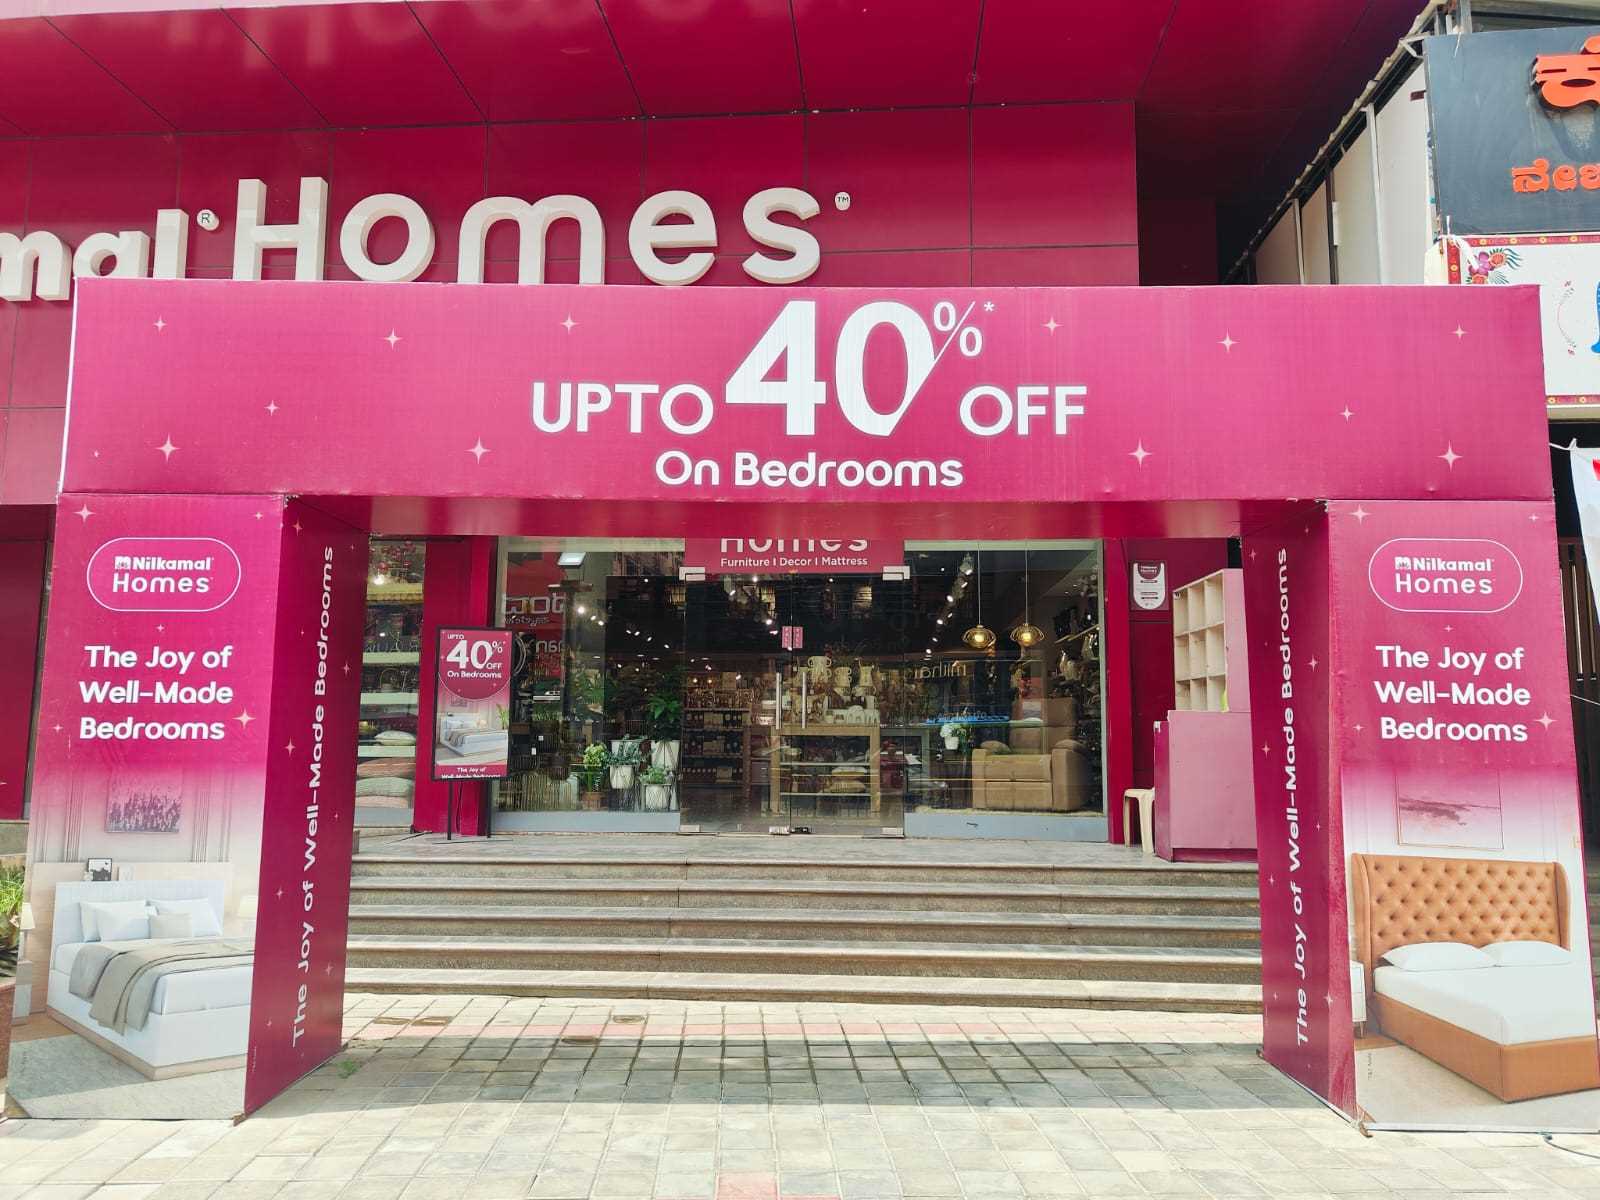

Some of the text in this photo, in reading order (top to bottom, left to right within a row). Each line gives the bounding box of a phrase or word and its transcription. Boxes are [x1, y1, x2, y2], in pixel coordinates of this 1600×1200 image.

[532, 381, 714, 435] UPTO
[959, 385, 1088, 436] OFF
[655, 450, 964, 489] On Bedrooms
[132, 556, 212, 571] Nilkamal
[720, 557, 770, 568] Furniture
[779, 557, 812, 567] Decor
[821, 556, 868, 567] Mattress
[1412, 557, 1493, 572] Nilkamal
[112, 572, 210, 593] Homes
[1395, 572, 1493, 595] Homes
[84, 645, 234, 675] The Joy of
[486, 662, 503, 670] OFF
[1375, 645, 1525, 676] The Joy of
[447, 670, 502, 679] On Bedrooms
[79, 680, 234, 705] Well-Made
[1374, 680, 1531, 706] Well-Made
[79, 716, 226, 740] Bedrooms
[1380, 716, 1528, 742] Bedrooms
[292, 546, 333, 1047] The Joy of Well-Made Bedrooms
[1278, 548, 1309, 1047] The Joy of Well-Made Bedrooms
